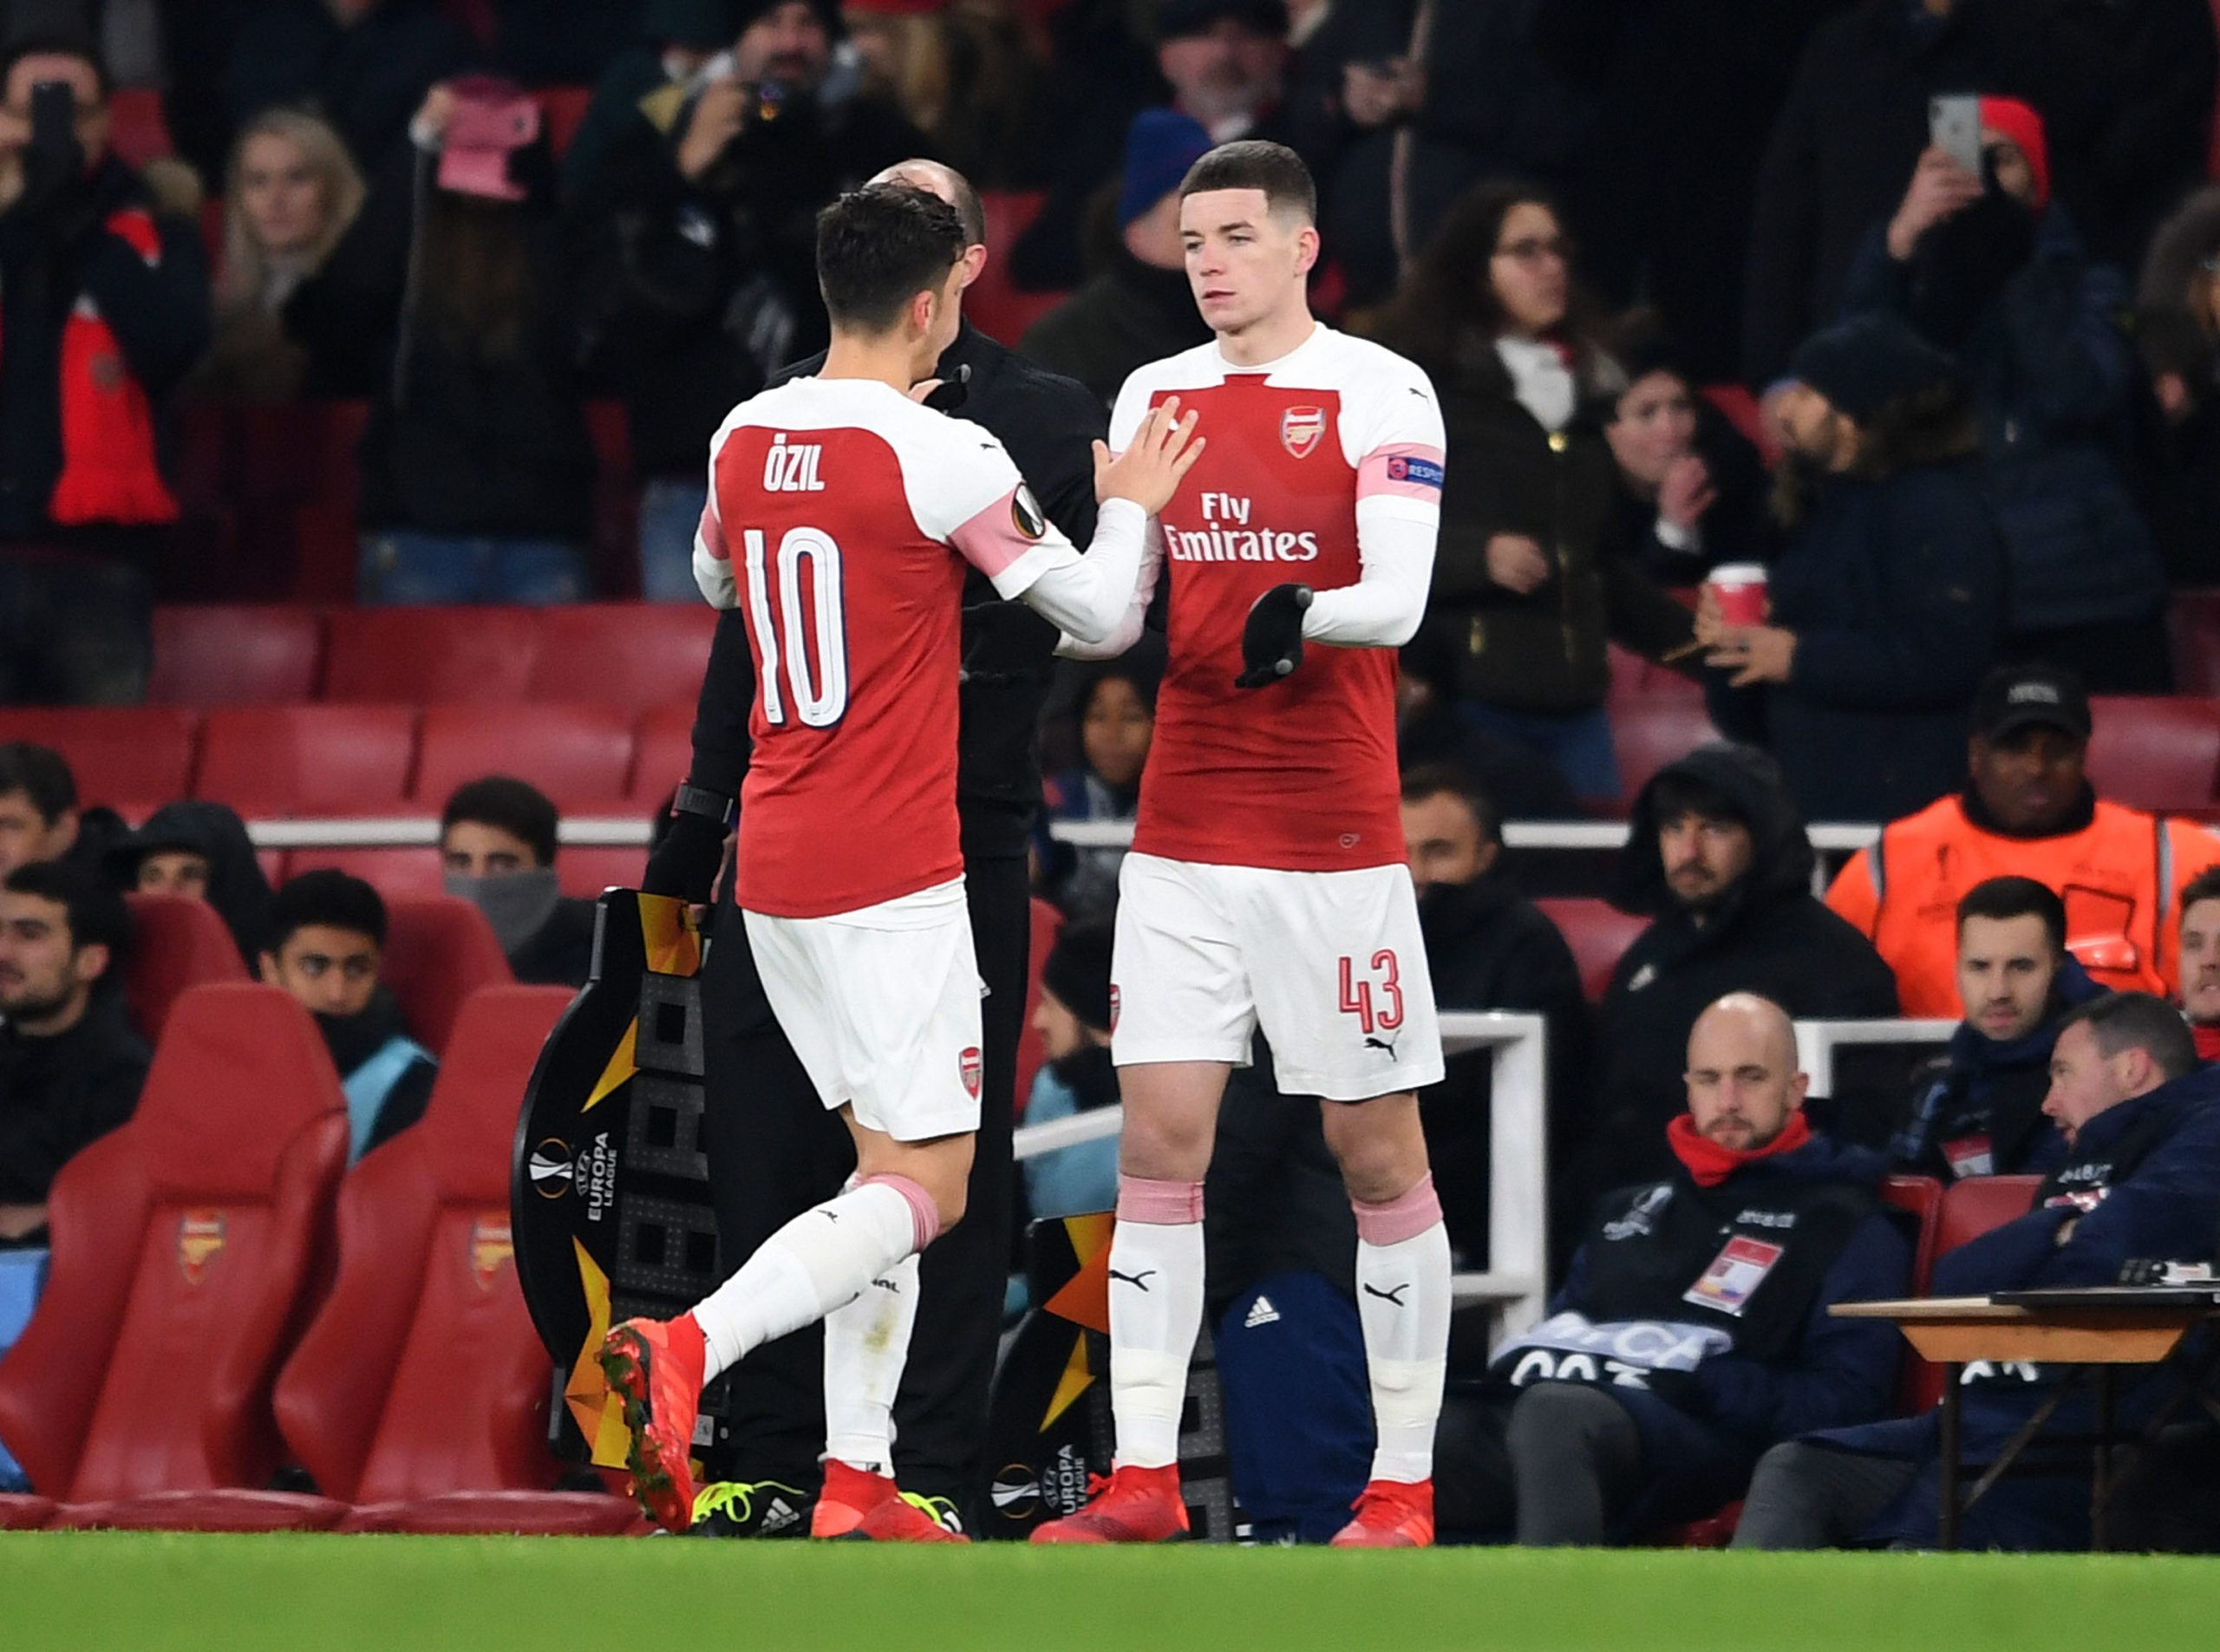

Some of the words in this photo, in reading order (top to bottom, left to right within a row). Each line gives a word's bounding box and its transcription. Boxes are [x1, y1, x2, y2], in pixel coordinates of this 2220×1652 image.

[1163, 522, 1318, 561] Emirates
[1201, 493, 1250, 524] Fly
[744, 526, 849, 728] 10
[1339, 949, 1404, 1034] 43
[588, 1132, 609, 1221] EUROPA
[604, 1149, 617, 1206] LEAGUE
[1058, 1444, 1075, 1514] UROPA
